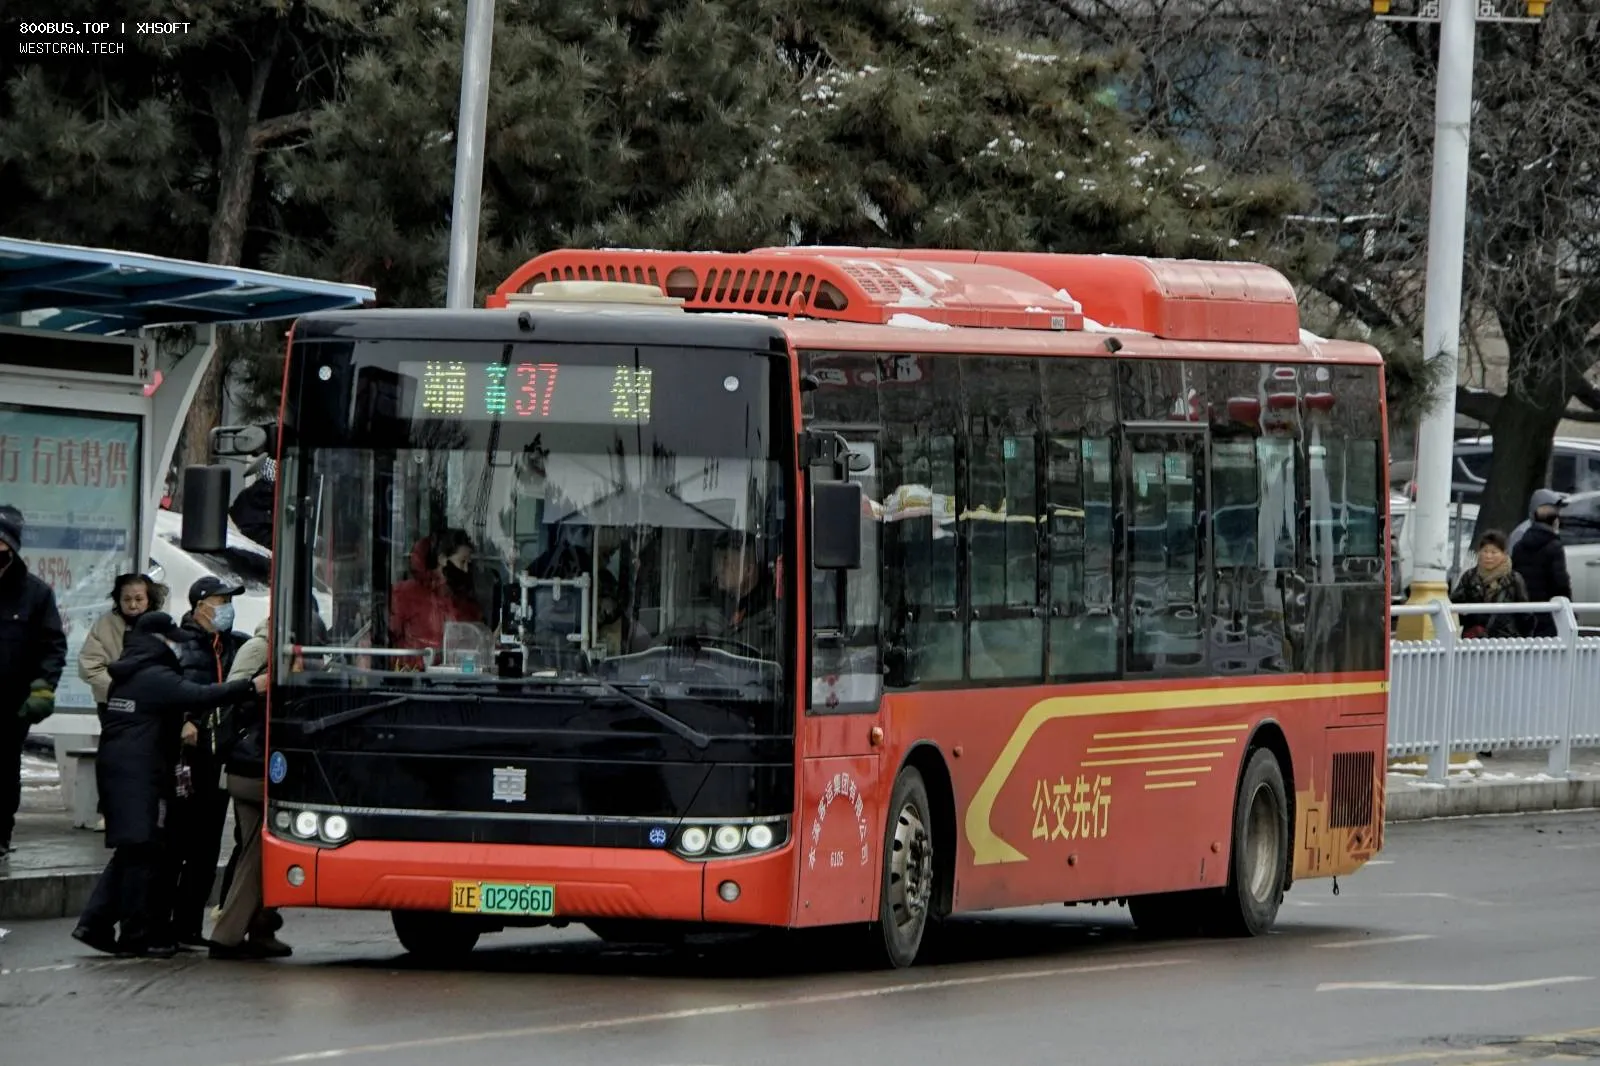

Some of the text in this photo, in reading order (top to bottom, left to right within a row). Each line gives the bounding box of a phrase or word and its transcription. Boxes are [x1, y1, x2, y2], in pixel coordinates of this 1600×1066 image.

[515, 363, 558, 416] 37
[1032, 774, 1112, 840] 公交先行
[454, 885, 552, 911] 辽E 02966D
